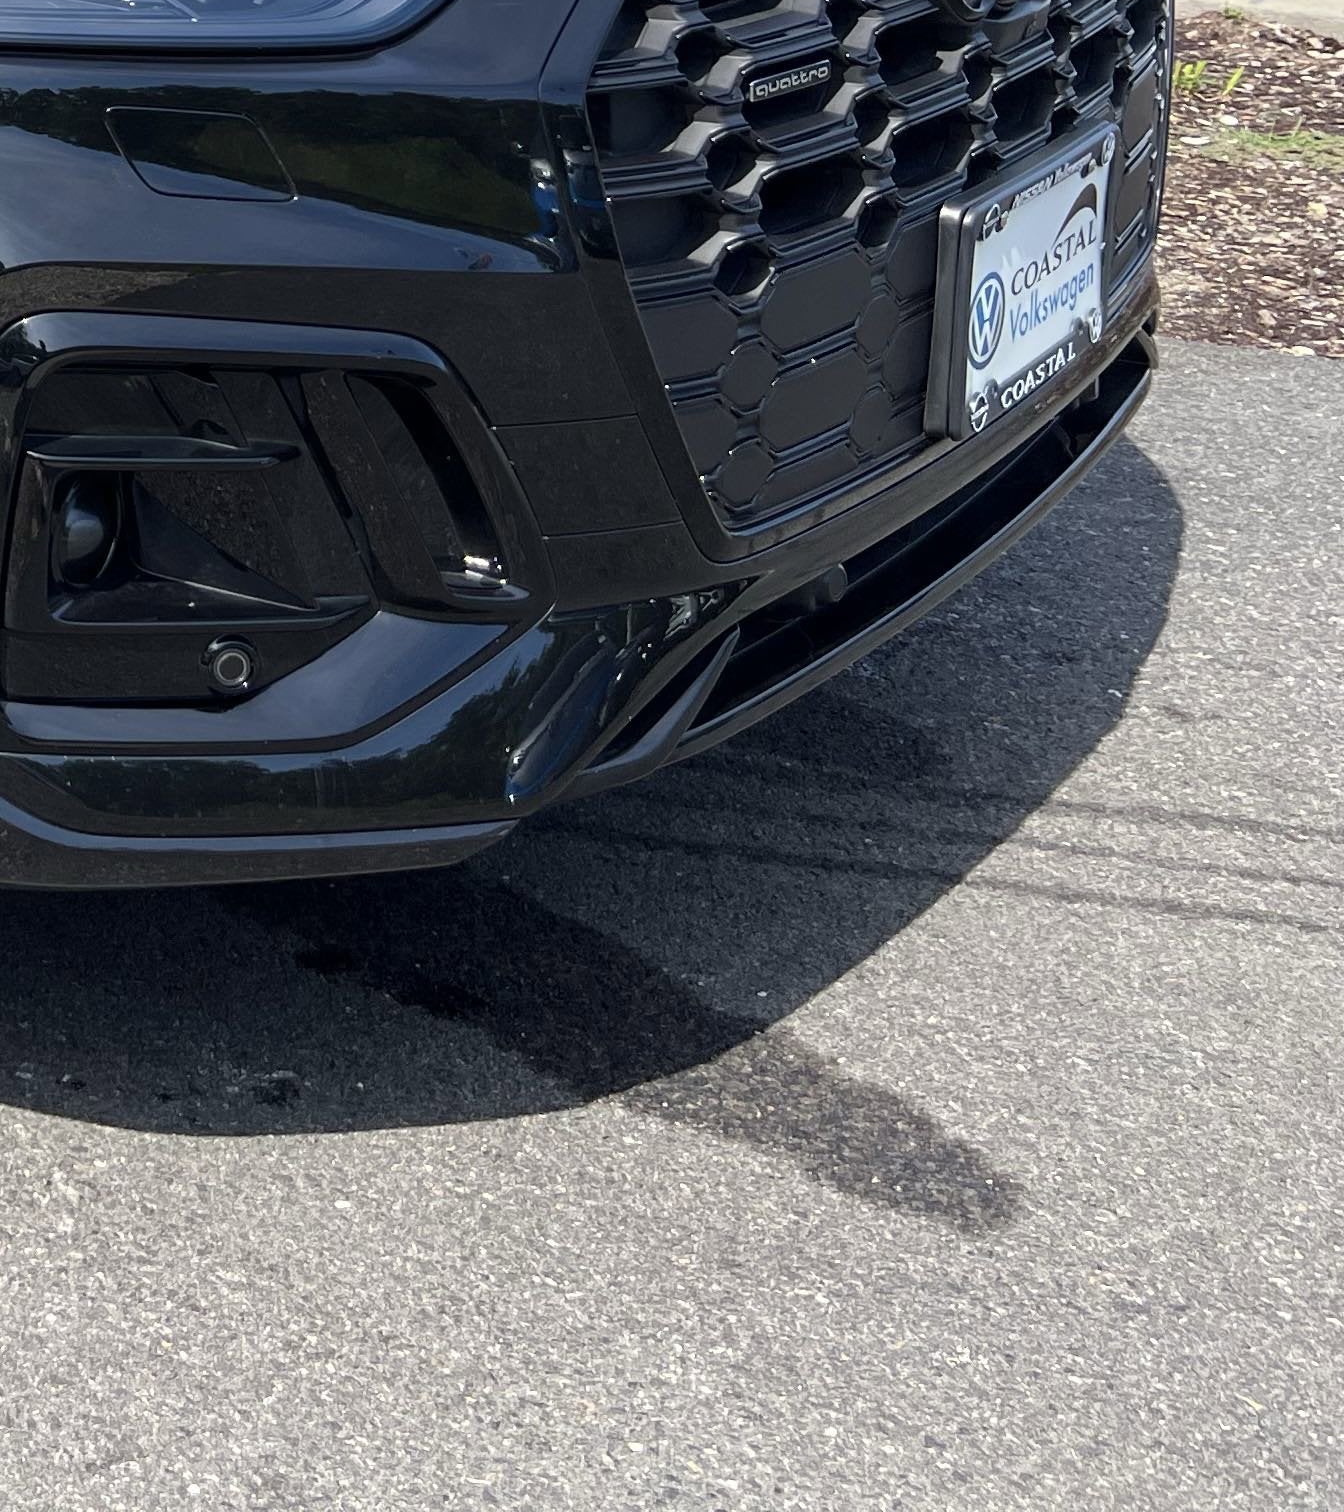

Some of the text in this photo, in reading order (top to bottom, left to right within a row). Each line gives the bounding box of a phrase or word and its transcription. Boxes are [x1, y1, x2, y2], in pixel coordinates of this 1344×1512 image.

[755, 66, 829, 97] quattro
[1010, 218, 1098, 296] COASTAL
[1009, 262, 1095, 344] Volkswagen
[1000, 341, 1077, 409] COASTAL
